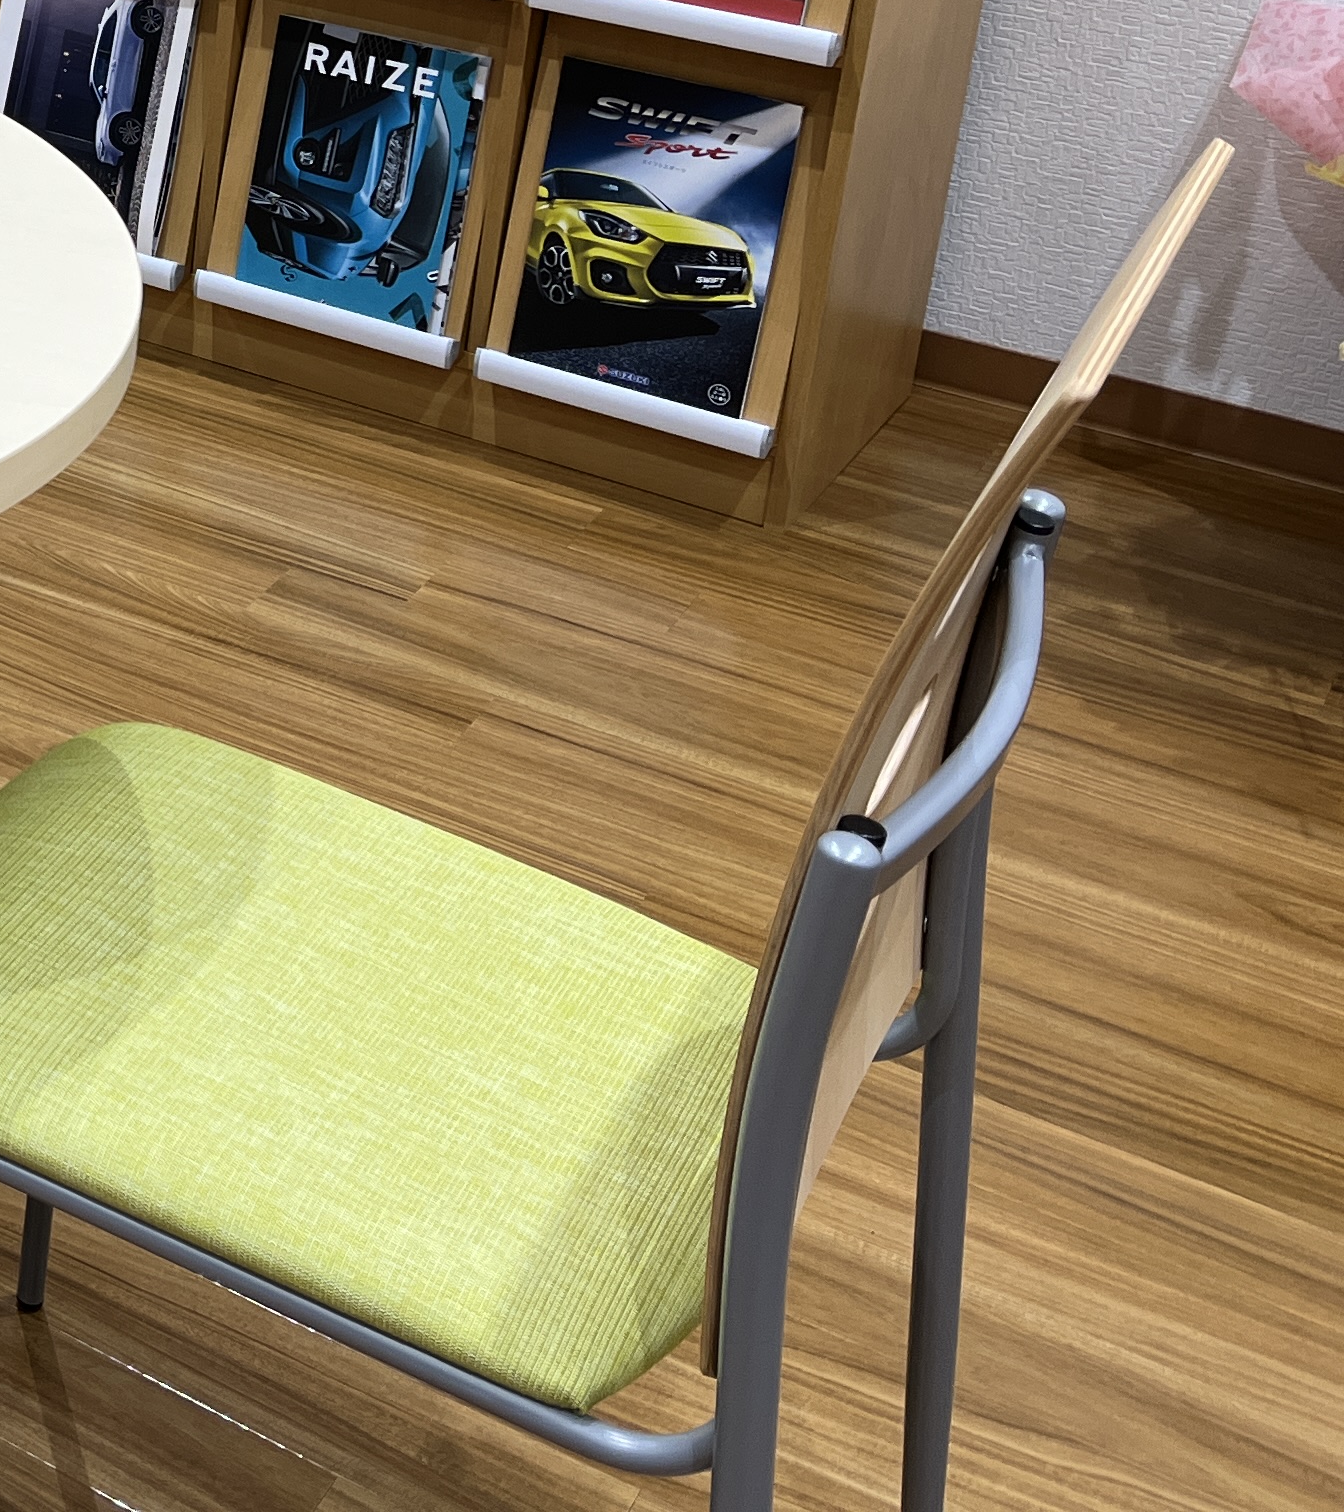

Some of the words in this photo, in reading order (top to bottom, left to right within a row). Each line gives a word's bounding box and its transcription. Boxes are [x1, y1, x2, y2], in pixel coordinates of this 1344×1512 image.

[303, 42, 440, 99] RAIZE
[587, 96, 759, 146] SWIFT
[614, 133, 739, 160] Sport
